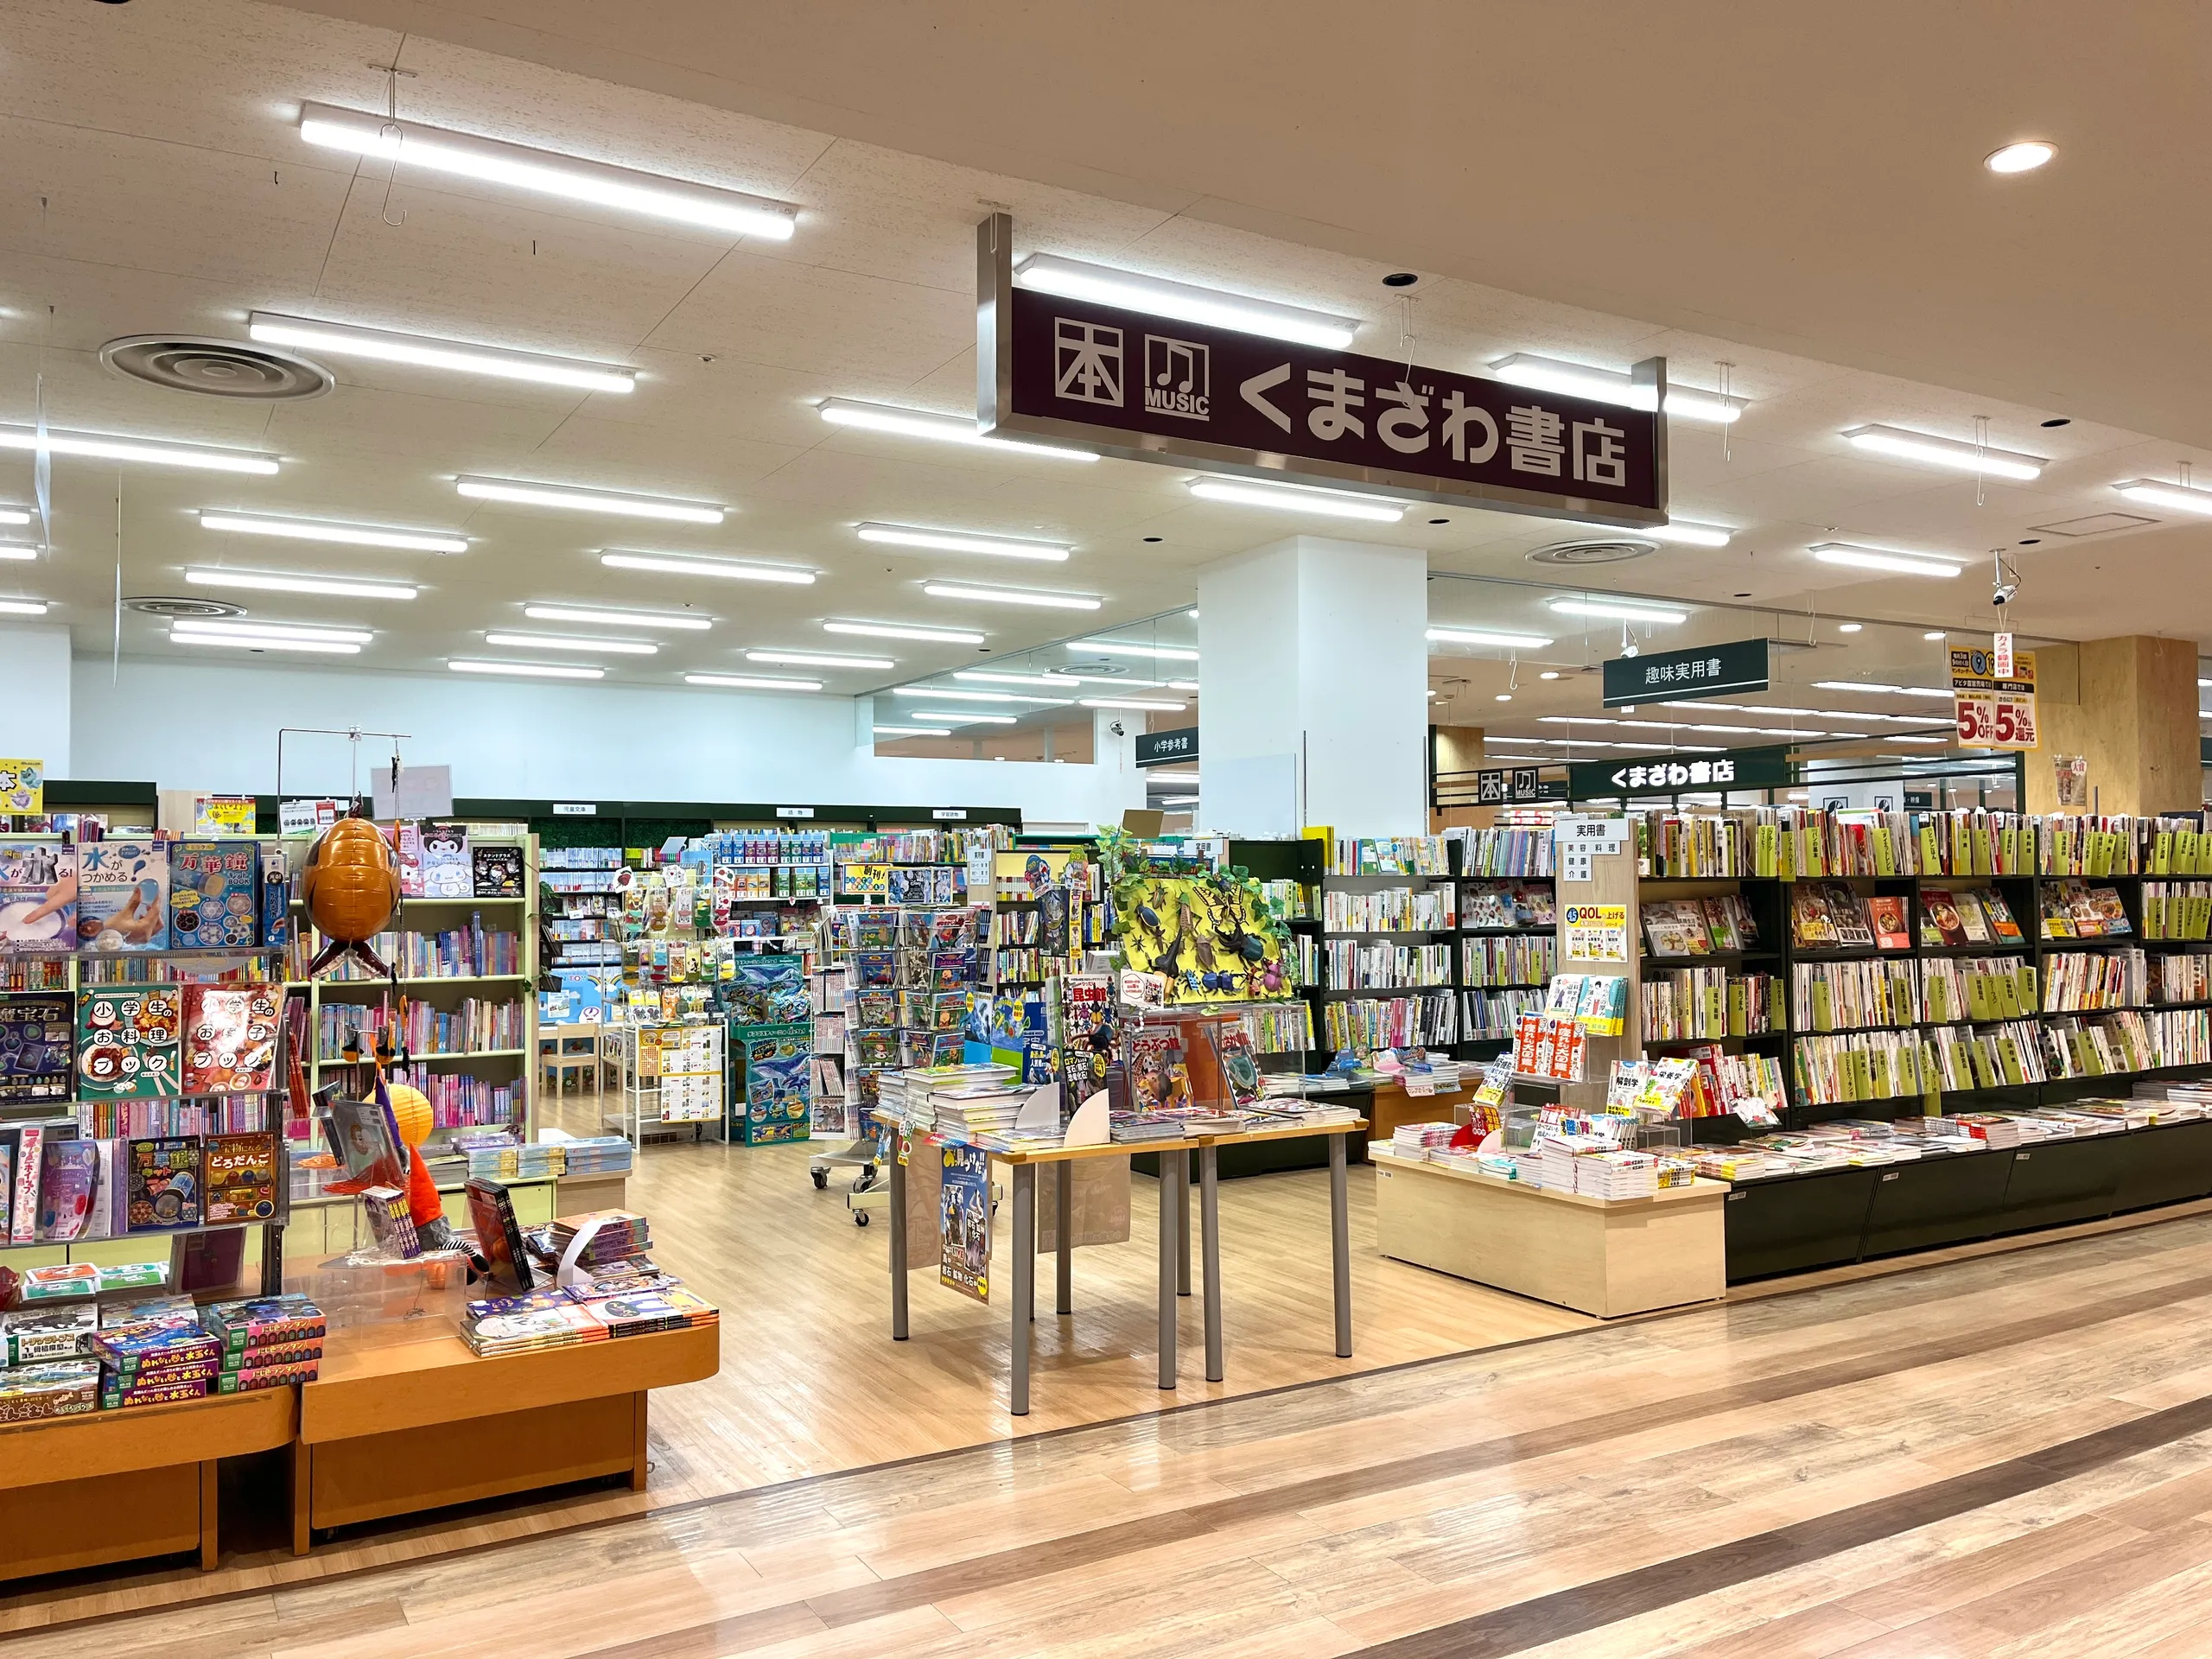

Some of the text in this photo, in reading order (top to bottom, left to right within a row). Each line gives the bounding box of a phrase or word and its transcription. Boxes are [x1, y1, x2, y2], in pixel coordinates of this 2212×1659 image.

[1144, 385, 1210, 416] MUSIC
[1239, 360, 1626, 486] くまざわ書店
[1645, 658, 1722, 685] 趣味実用書
[1978, 724, 1993, 740] OFF
[2015, 728, 2035, 742] 還元
[1154, 737, 1188, 753] 小学参考書
[1611, 760, 1734, 788] くまざわ書店
[1516, 788, 1536, 797] MUSIC
[1577, 823, 1605, 836] 実用書
[1595, 843, 1615, 853] 料理
[180, 852, 249, 874] 万華鏡
[1568, 870, 1586, 879] 介護
[1073, 987, 1106, 1002] 昆虫館
[96, 1001, 171, 1017] 小学生の
[96, 1028, 167, 1042] お料理
[1132, 1038, 1181, 1052] どうぶつ館
[95, 1057, 167, 1072] ブック
[1616, 1077, 1638, 1087] 解剖学
[137, 1150, 188, 1167] 万華鏡
[212, 1153, 270, 1169] どろだんご
[262, 1321, 308, 1332] にじ色ランタン
[22, 1333, 75, 1347] トリケラトプス
[257, 1343, 303, 1354] にじ色ランタン
[142, 1350, 215, 1369] ぬれない砂と水玉くん
[137, 1369, 213, 1387] ぬれない砂と水玉くん
[253, 1366, 299, 1377] にじ色ランタン
[124, 1389, 200, 1406] ぬれない砂と水玉くん
